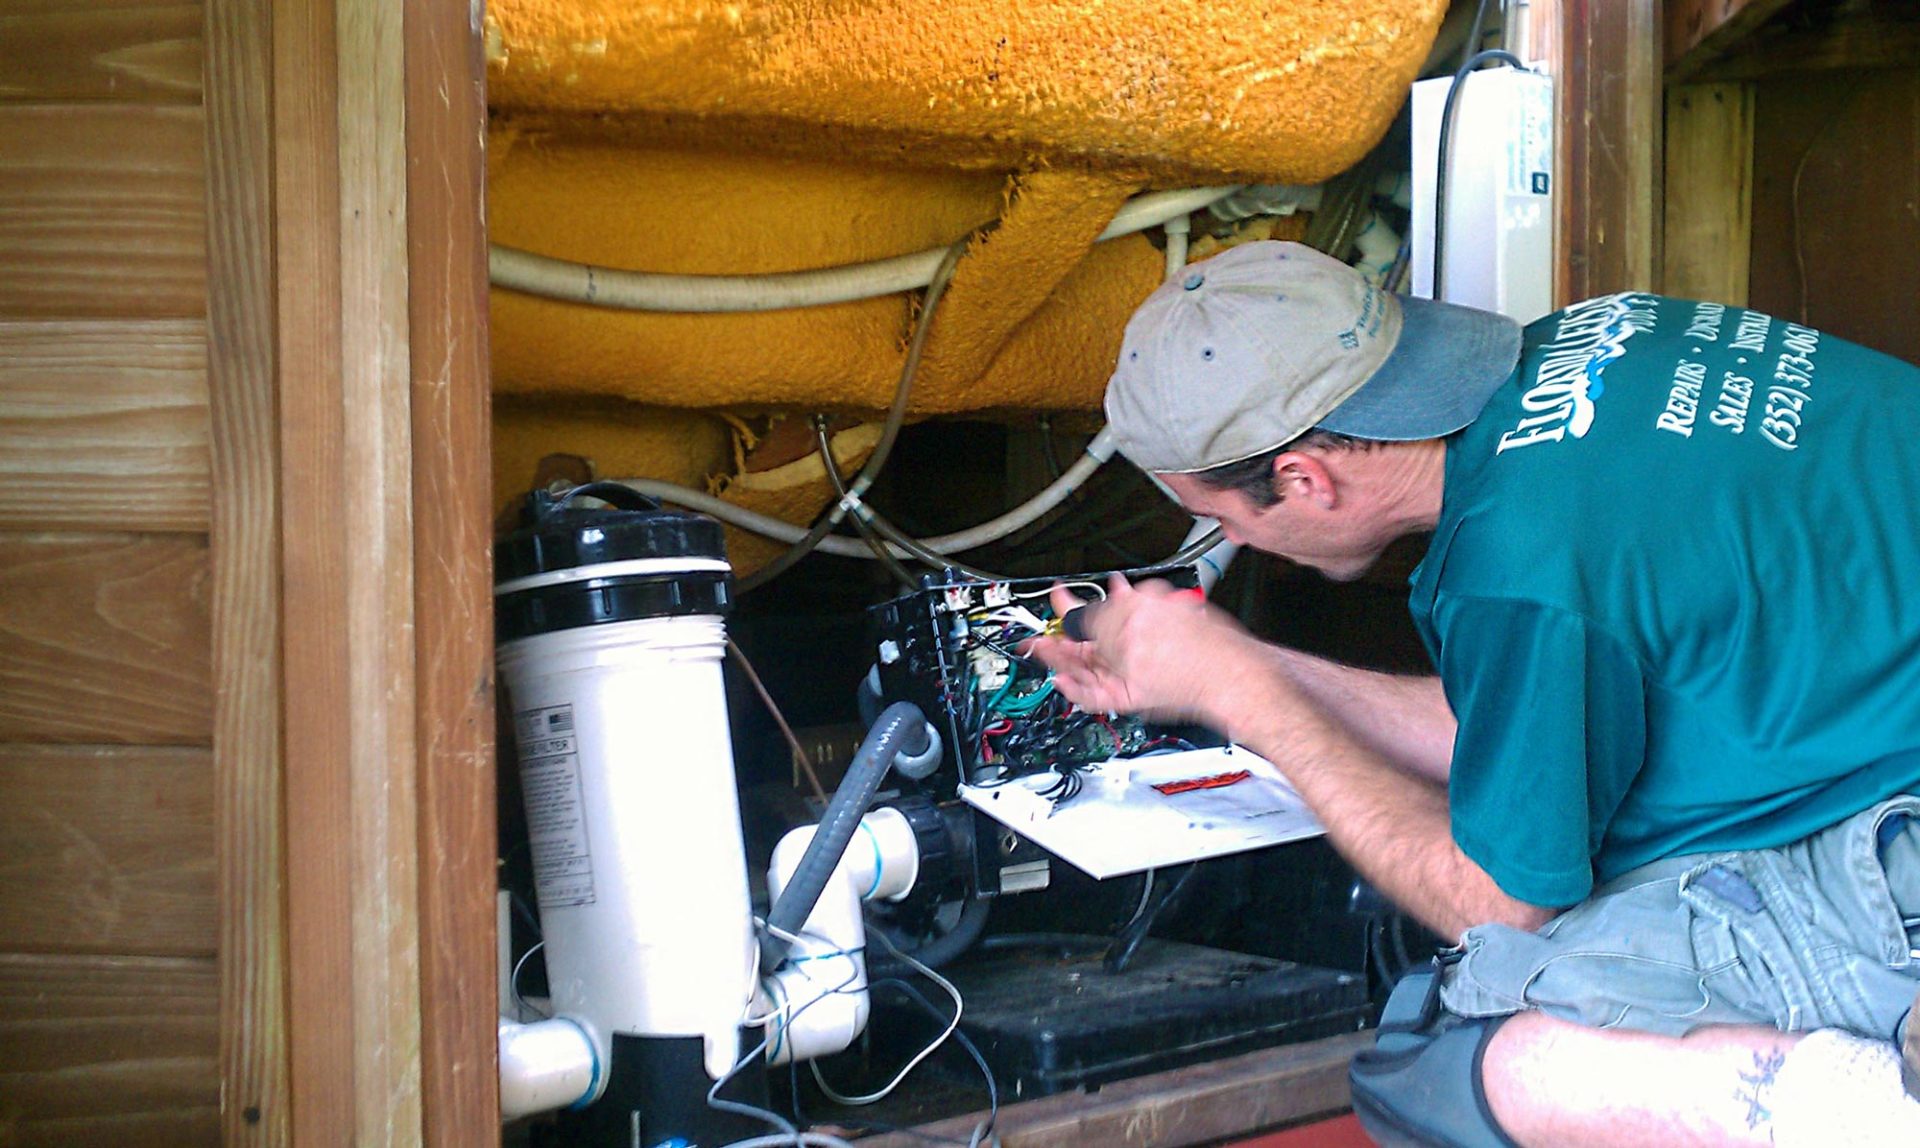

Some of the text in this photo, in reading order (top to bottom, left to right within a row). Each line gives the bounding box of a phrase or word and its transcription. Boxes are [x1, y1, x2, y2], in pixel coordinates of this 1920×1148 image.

[1656, 359, 1707, 438] REPAIRS
[1710, 371, 1754, 434] SALES
[1760, 385, 1812, 451] (352)
